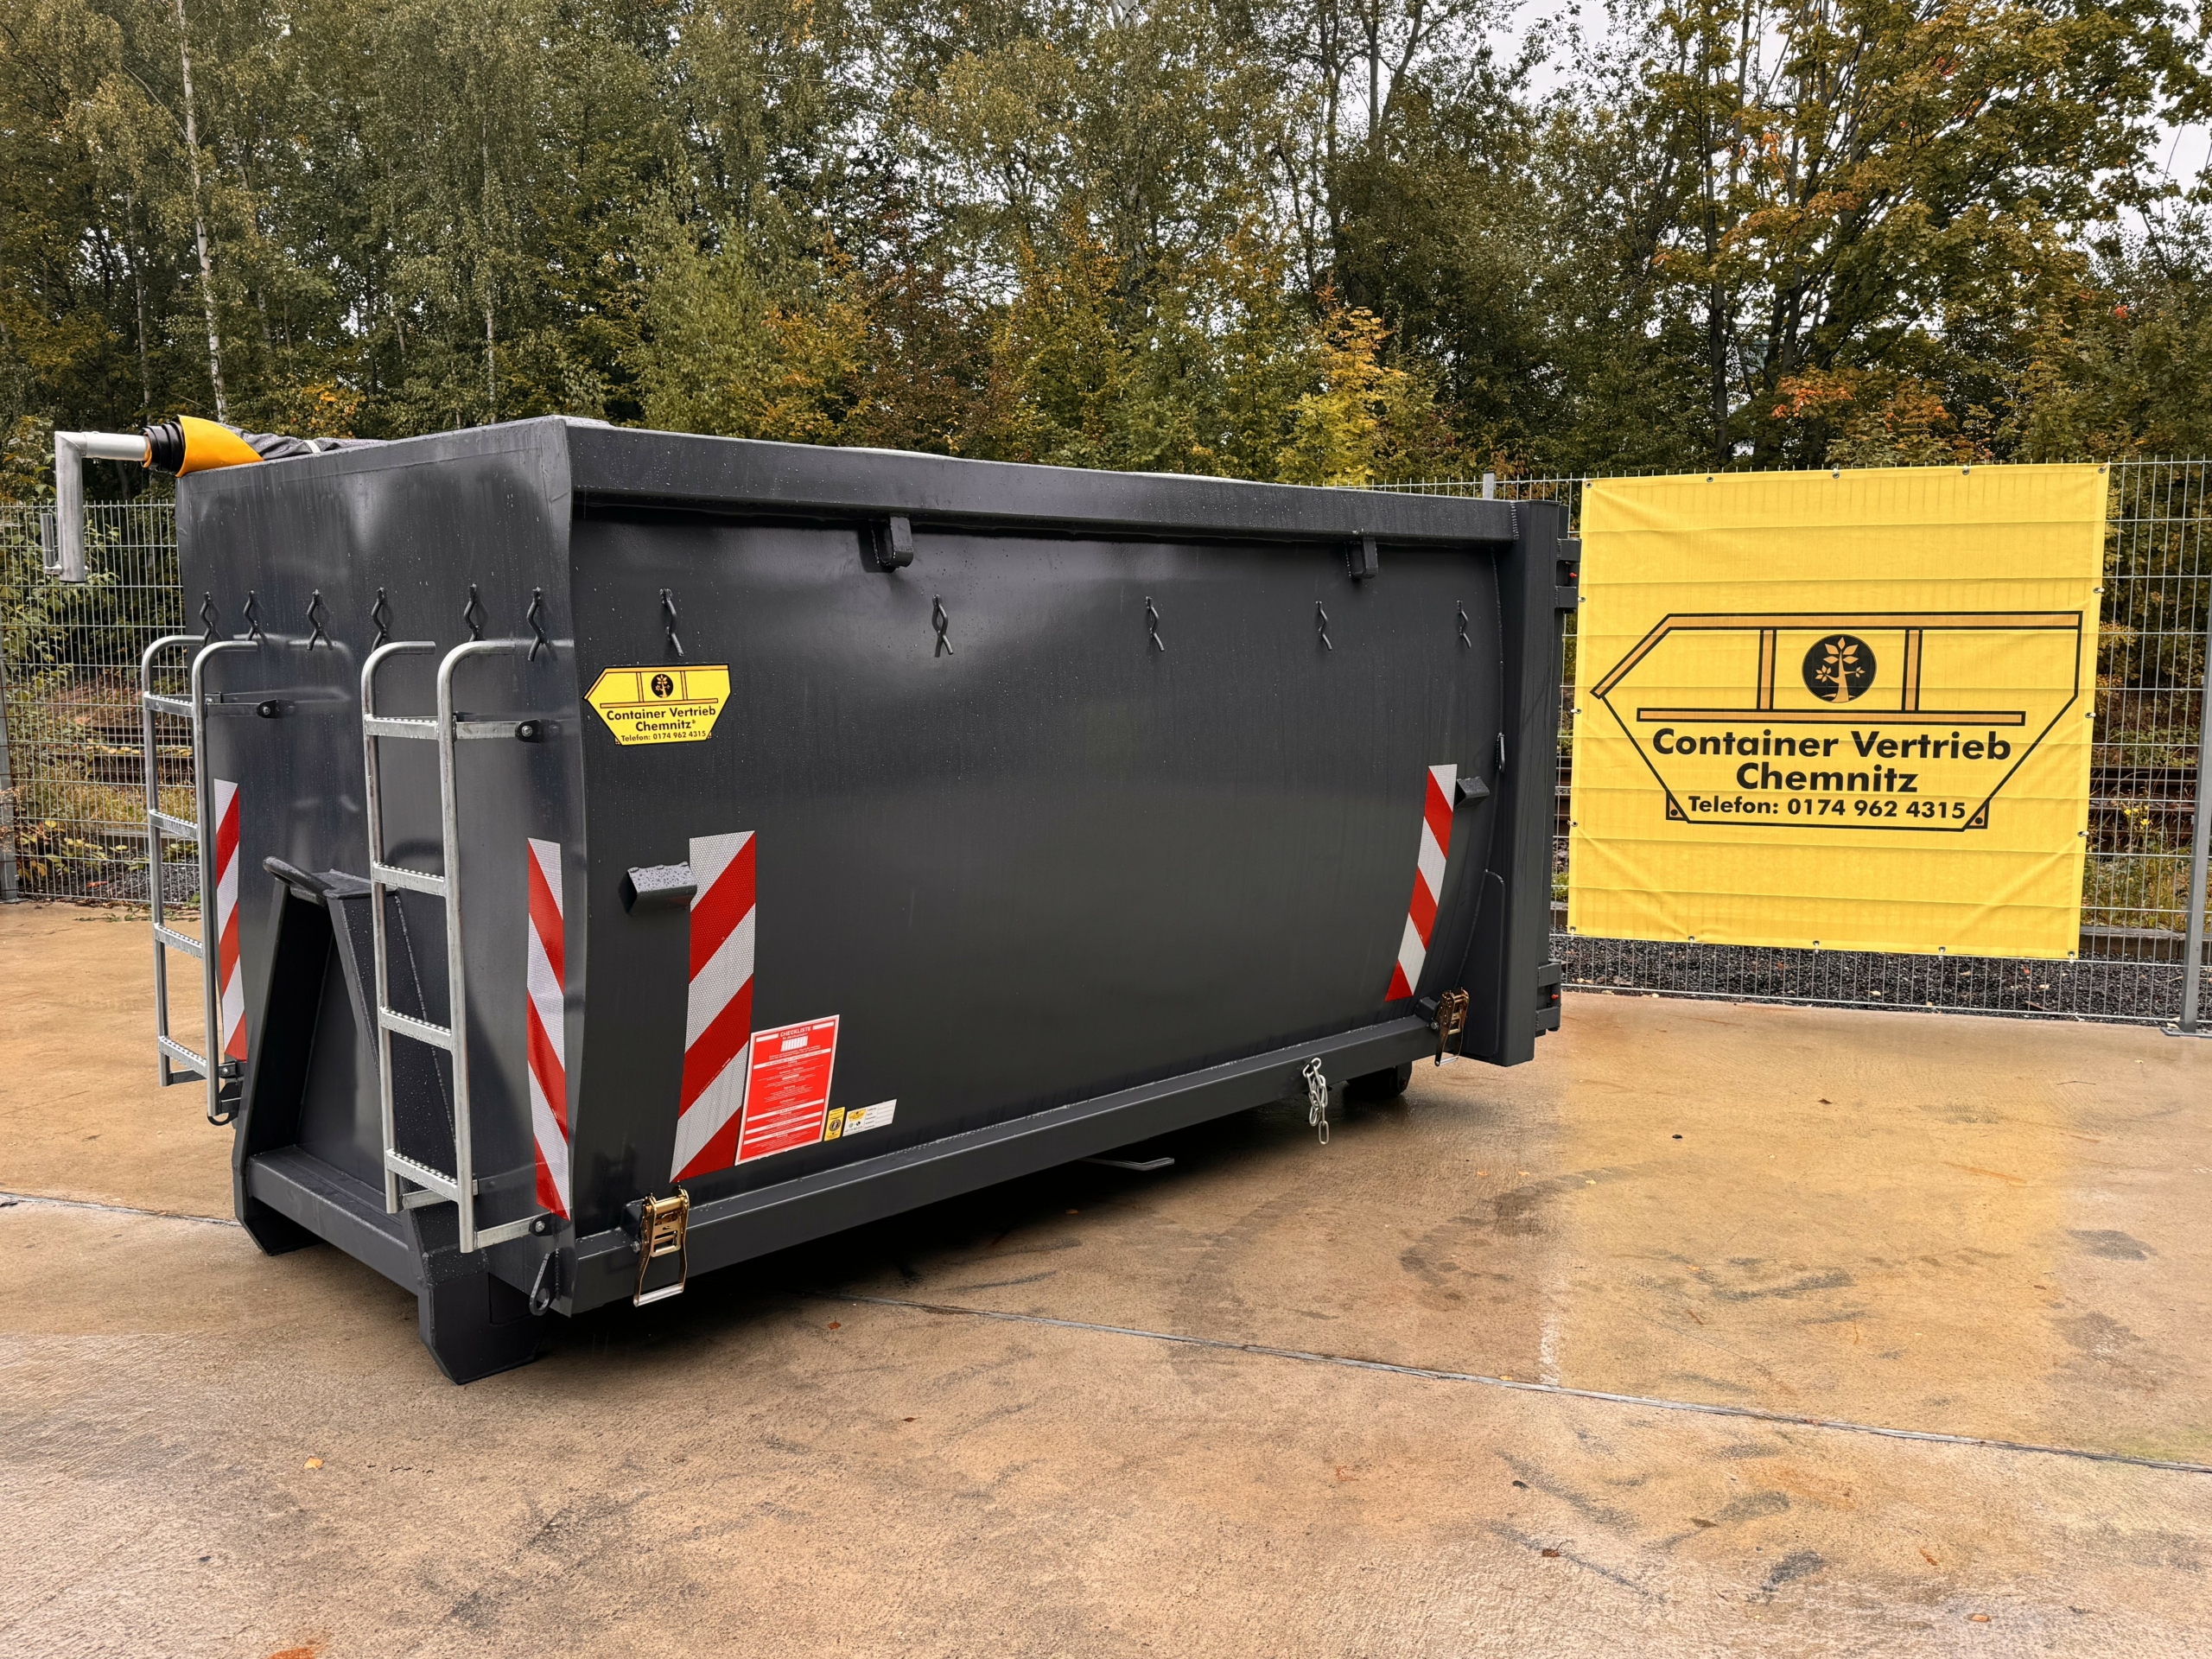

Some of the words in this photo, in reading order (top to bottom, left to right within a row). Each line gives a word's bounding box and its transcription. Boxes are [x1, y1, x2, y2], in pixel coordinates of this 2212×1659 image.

[607, 709, 666, 721] Container
[670, 705, 716, 717] Vertrieb
[621, 734, 651, 742] Telefon:
[1653, 728, 1840, 757] Container
[1850, 730, 2012, 760] Vertrieb
[1736, 762, 1918, 793] Chemnitz
[1688, 795, 1779, 816] Telefon:
[1787, 798, 1846, 817] 0174
[1853, 799, 1898, 818] 962
[1906, 800, 1967, 820] 4315
[779, 1027, 811, 1037] CHECKLISTE
